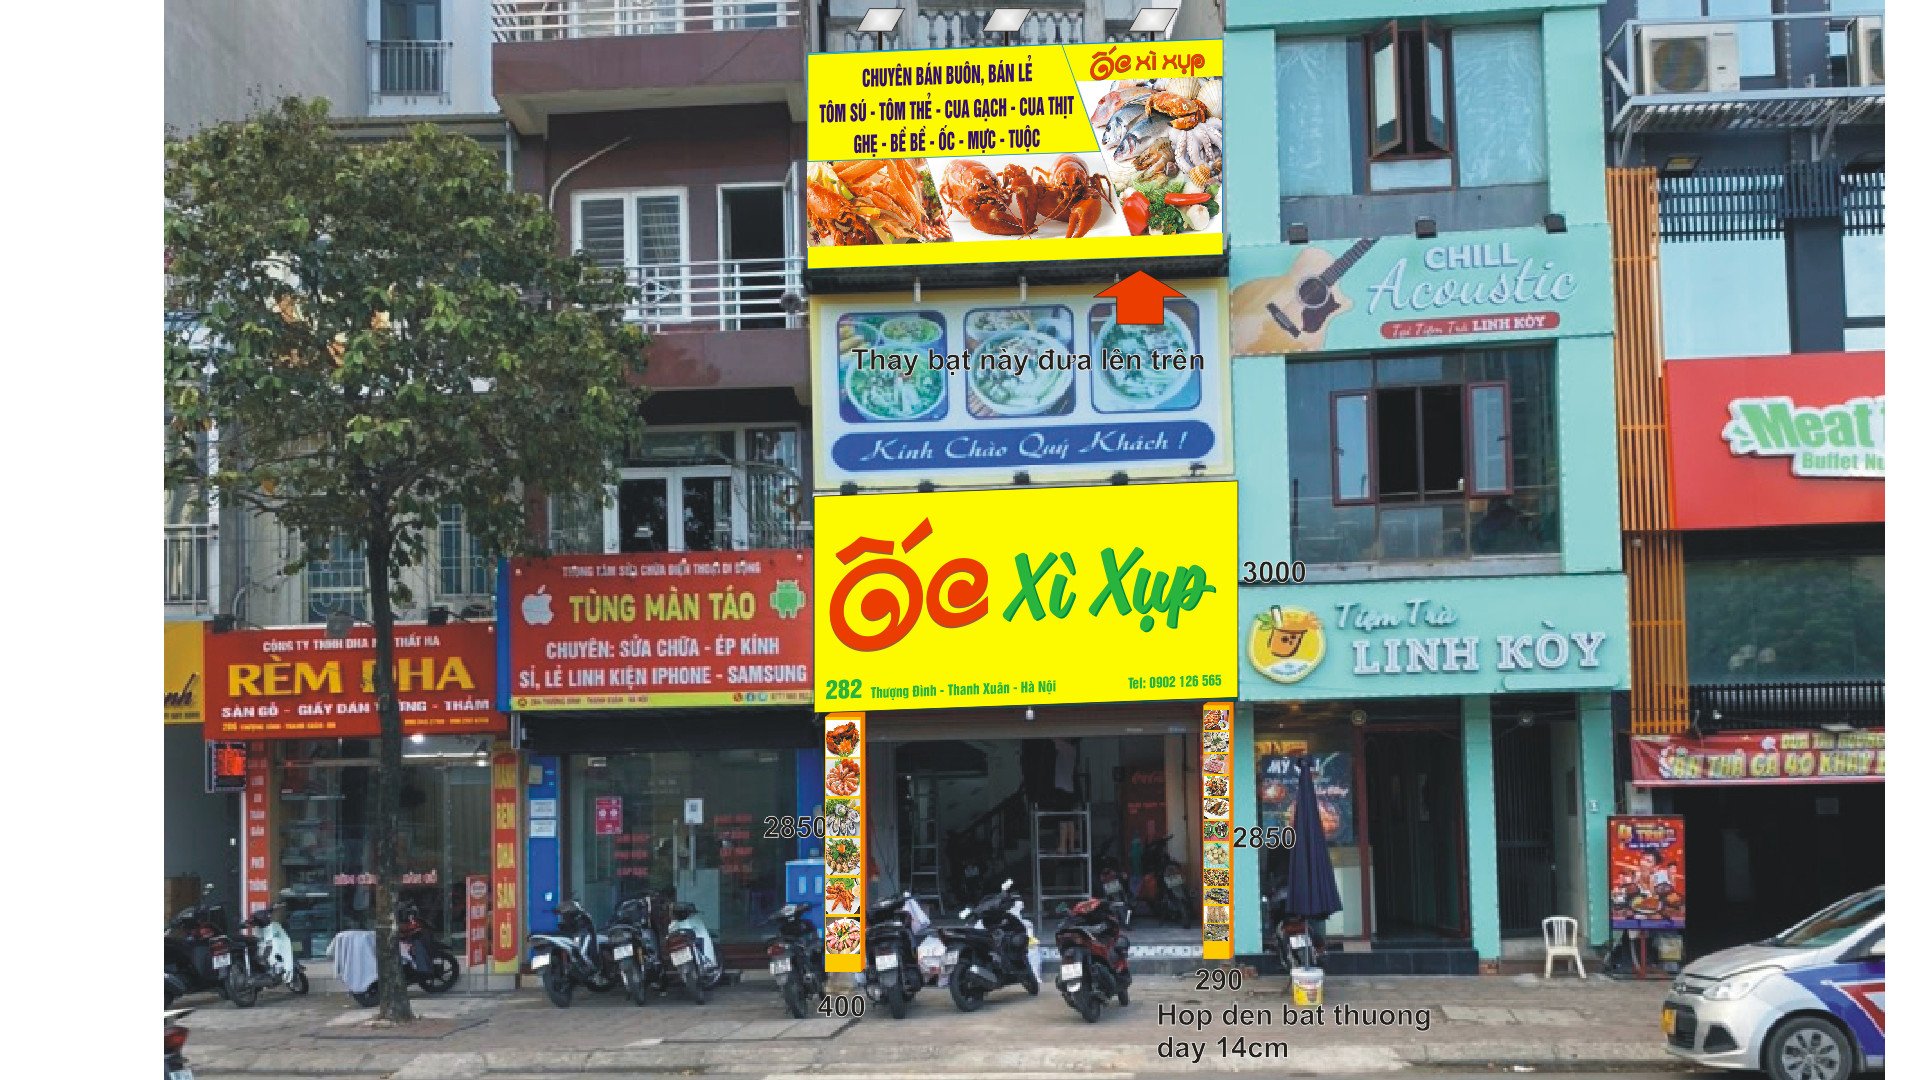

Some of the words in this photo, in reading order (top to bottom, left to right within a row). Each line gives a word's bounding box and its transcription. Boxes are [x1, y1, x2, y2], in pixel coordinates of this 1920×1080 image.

[863, 64, 911, 87] CHUYÊN
[916, 63, 941, 85] BÁN
[946, 61, 984, 85] BUÔN,
[989, 60, 1014, 83] BÁN
[1019, 55, 1032, 81] LẺ
[1090, 46, 1131, 80] Ốc
[1136, 51, 1157, 71] xì
[1161, 53, 1205, 76] xụp
[820, 100, 845, 122] TÔM
[850, 99, 866, 122] SÚ
[879, 98, 905, 120] TÔM
[910, 93, 931, 119] THẺ
[945, 100, 969, 118] CUA
[974, 98, 1006, 121] GẠCH
[1020, 97, 1044, 116] CUA
[1048, 96, 1074, 119] THỊT
[854, 134, 877, 156] GHẸ
[891, 127, 906, 152] BỀ
[911, 126, 925, 151] BỀ
[939, 125, 954, 150] ỐC
[968, 129, 995, 153] MỰC
[1009, 125, 1040, 151] TUỘC
[1424, 242, 1518, 270] CHILL
[1367, 257, 1577, 315] Acoustic
[1472, 317, 1512, 332] LINH
[1738, 402, 1876, 448] Meat
[1079, 430, 1170, 454] Khách
[1802, 453, 1859, 470] Buffet
[830, 518, 988, 652] Ốc
[1003, 552, 1076, 622] Xì
[1089, 547, 1216, 632] Xụp
[568, 587, 636, 624] TÙNG
[645, 585, 700, 622] MÀN
[708, 584, 756, 620] TÁO
[296, 639, 310, 651] TY
[546, 637, 615, 660] CHUYÊN:
[619, 633, 652, 658] SỬA
[656, 635, 700, 657] CHỮA
[715, 633, 736, 656] ÉP
[740, 633, 780, 655] KÍNH
[1352, 636, 1480, 675] LINH
[1496, 619, 1606, 670] KÒY
[228, 653, 342, 697] RÈM
[568, 668, 606, 687] LINH
[609, 665, 647, 691] KIỆN
[652, 665, 712, 685] IPHONE
[727, 664, 807, 684] SAMSUNG
[1128, 678, 1145, 688] Tel:
[1150, 676, 1175, 688] 0902
[1180, 675, 1198, 687] 126
[1202, 675, 1221, 686] 565
[826, 679, 862, 699] 282
[871, 687, 908, 700] Thượng
[913, 685, 936, 697] Đình
[948, 684, 979, 695] Thanh
[983, 682, 1009, 694] Xuân
[1021, 681, 1034, 692] Hà
[1039, 680, 1055, 694] Nội
[221, 705, 256, 718] SÀN
